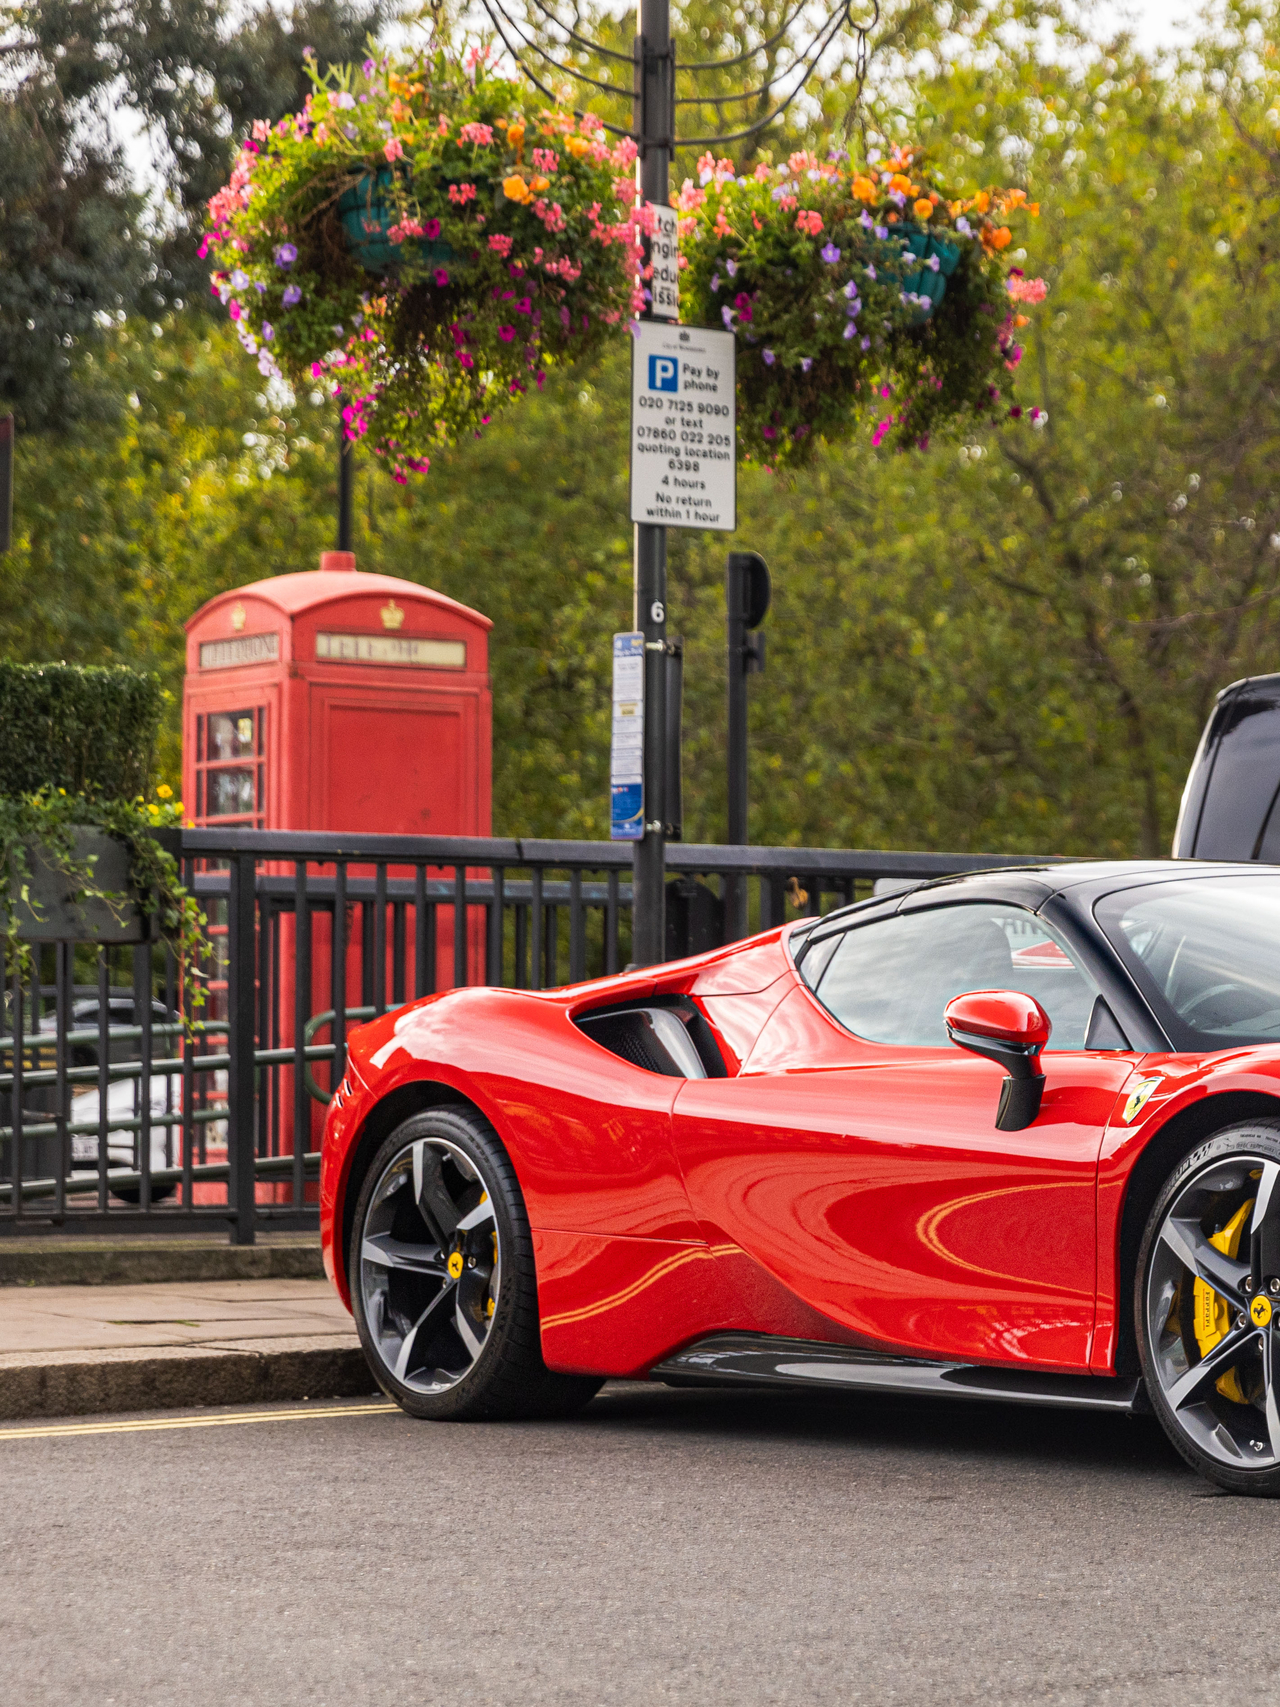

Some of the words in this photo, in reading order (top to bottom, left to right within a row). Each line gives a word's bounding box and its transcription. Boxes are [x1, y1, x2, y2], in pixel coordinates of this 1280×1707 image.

[655, 359, 674, 388] P
[682, 362, 702, 378] Pay
[706, 365, 720, 380] by
[683, 379, 718, 392] phone
[638, 395, 664, 409] 020
[667, 398, 694, 412] 7125
[697, 402, 730, 416] 9090
[664, 416, 676, 425] or
[680, 415, 704, 429] text
[680, 430, 704, 444] 022
[707, 433, 731, 447] 205
[637, 442, 681, 457] quoting
[684, 445, 731, 461] location
[668, 458, 700, 473] 6398
[661, 474, 669, 486] 4
[673, 475, 706, 490] hours
[655, 491, 672, 504] No
[676, 495, 712, 508] return
[646, 506, 682, 519] within
[685, 509, 690, 519] 1
[694, 509, 720, 522] hour
[651, 601, 665, 623] 6
